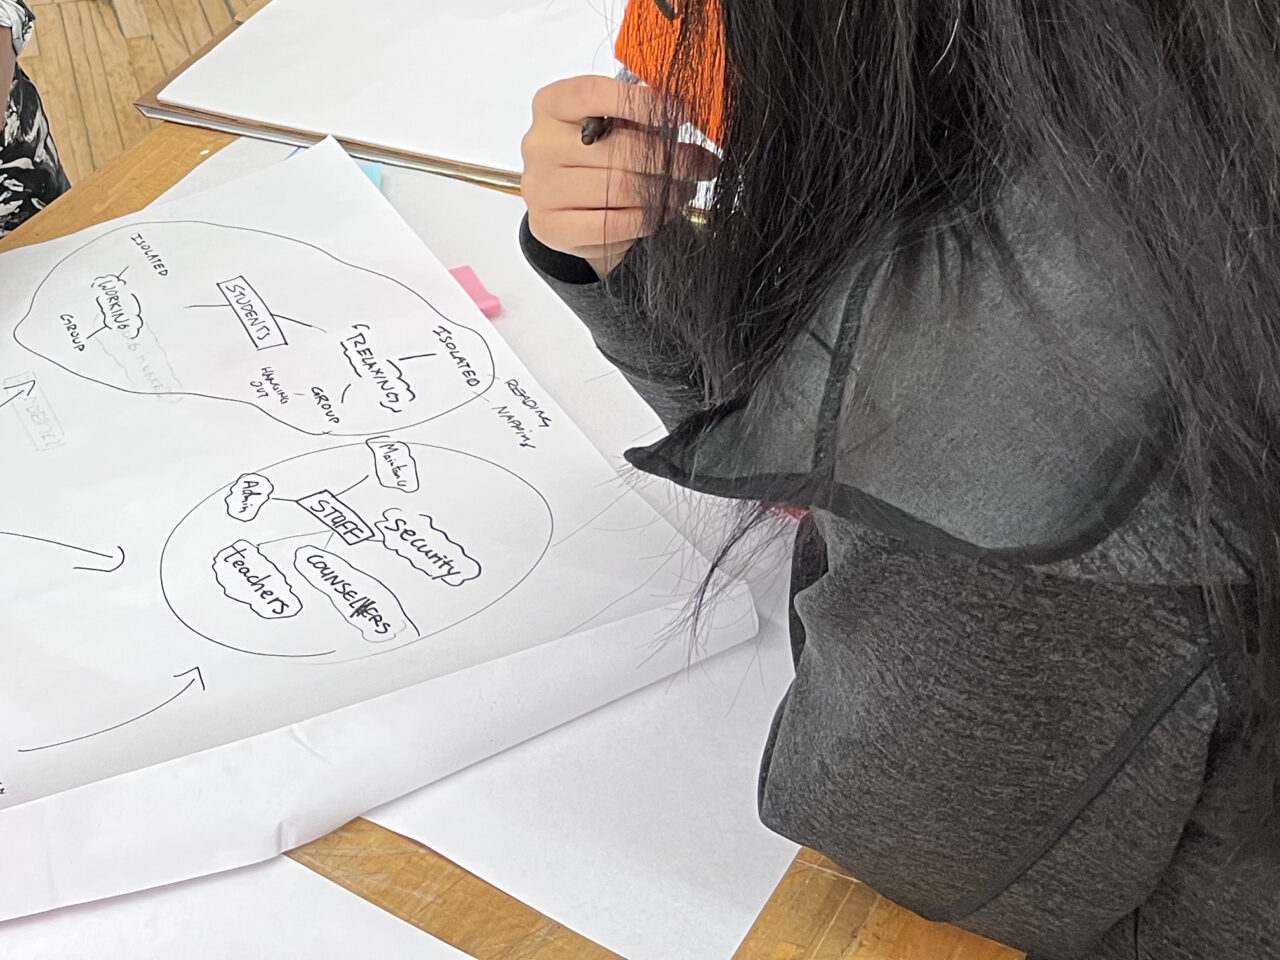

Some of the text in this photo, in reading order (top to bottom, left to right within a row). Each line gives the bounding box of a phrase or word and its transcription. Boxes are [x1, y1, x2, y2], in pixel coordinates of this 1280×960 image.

[130, 233, 169, 277] ISOLATED
[59, 313, 86, 352] GROUP
[225, 284, 270, 341] STUDENTS
[346, 332, 400, 403] RELAXING
[432, 325, 480, 387] ISOLATED
[311, 386, 340, 424] GROUP
[239, 480, 262, 513] Admin
[223, 544, 290, 615] teachers
